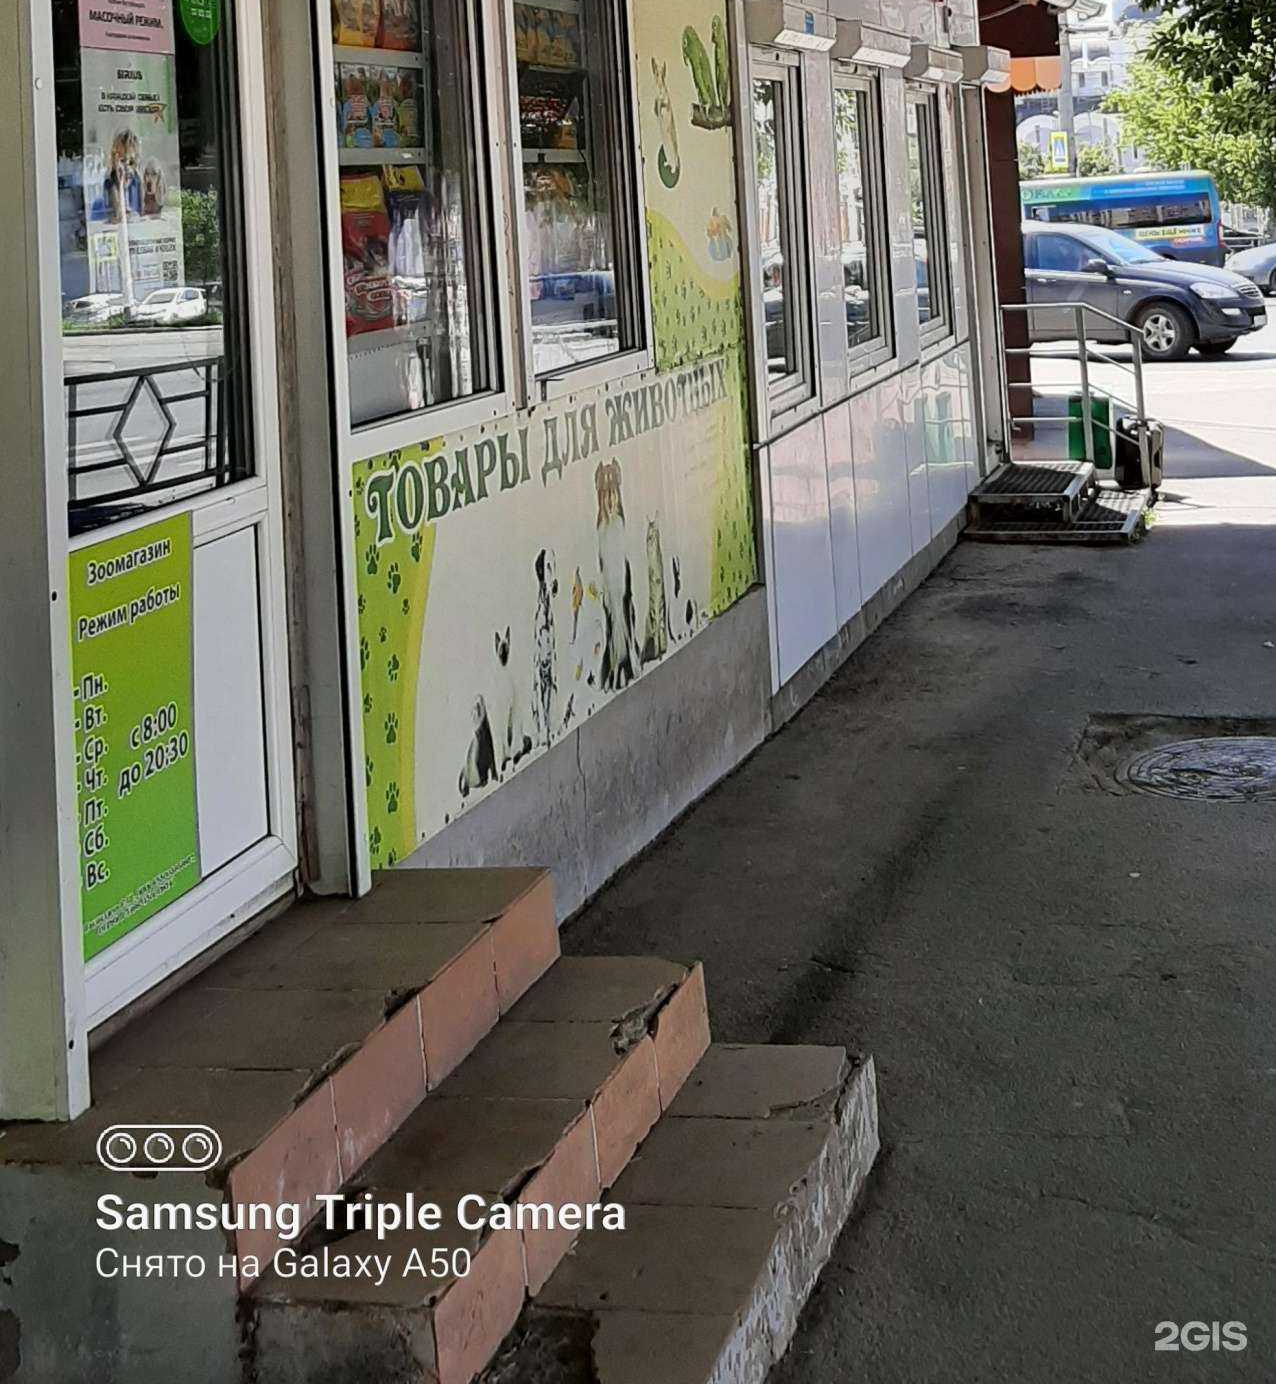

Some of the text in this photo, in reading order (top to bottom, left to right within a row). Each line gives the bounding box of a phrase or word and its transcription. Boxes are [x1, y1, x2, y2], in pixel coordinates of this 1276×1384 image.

[89, 9, 135, 26] МАСОЧНЫЙ
[366, 358, 729, 543] ТОВАРЫ ДЛЯ ЖИВОТНЫХ
[87, 538, 171, 584] Зоомагазин
[78, 582, 180, 641] Режим работы
[82, 673, 108, 699] Пн.
[83, 704, 107, 731] Вт.
[130, 703, 177, 749] с 8:00
[84, 736, 107, 765] Ср.
[118, 733, 189, 796] до 20:30
[84, 766, 107, 795] Чт.
[84, 798, 108, 827] Пт.
[84, 829, 109, 857] Сб.
[85, 860, 110, 889] Вс.
